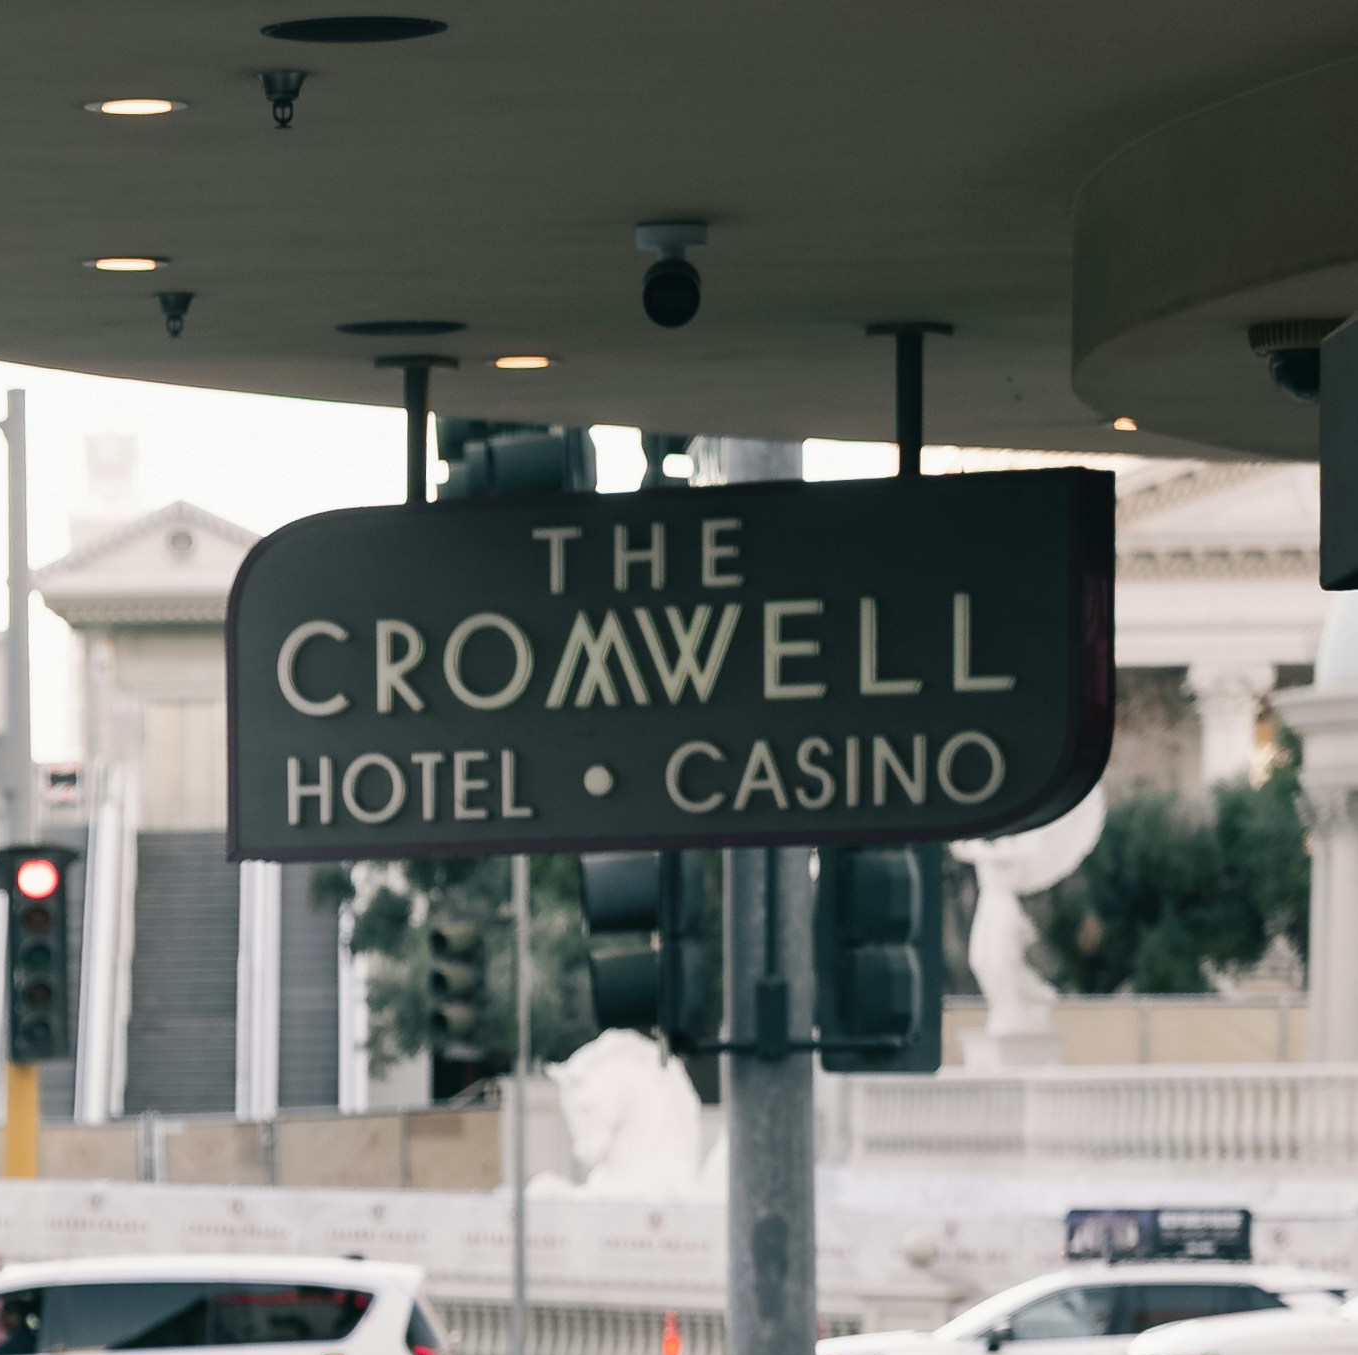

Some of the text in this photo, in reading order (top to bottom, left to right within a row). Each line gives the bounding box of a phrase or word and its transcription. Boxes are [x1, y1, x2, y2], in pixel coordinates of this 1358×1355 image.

[531, 517, 745, 595] THE
[276, 592, 1016, 717] CROMWELL
[286, 730, 1005, 826] HOTEL CASINO
